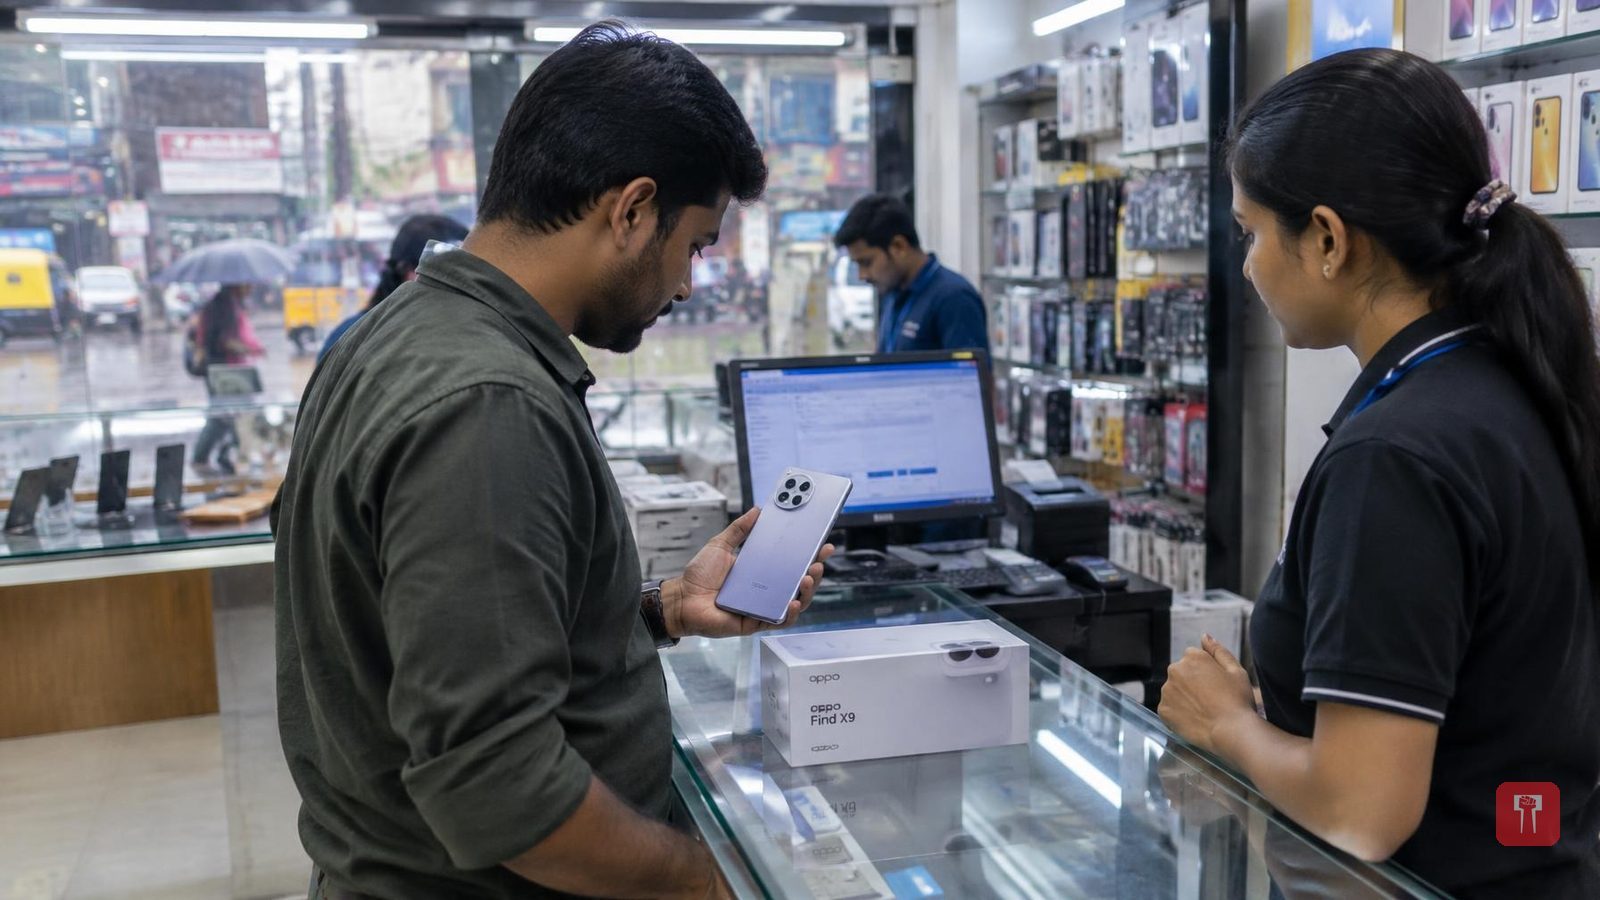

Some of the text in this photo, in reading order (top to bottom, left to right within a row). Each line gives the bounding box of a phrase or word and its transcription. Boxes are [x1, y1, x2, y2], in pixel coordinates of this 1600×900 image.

[809, 673, 840, 684] oppo
[810, 712, 856, 726] Find X9
